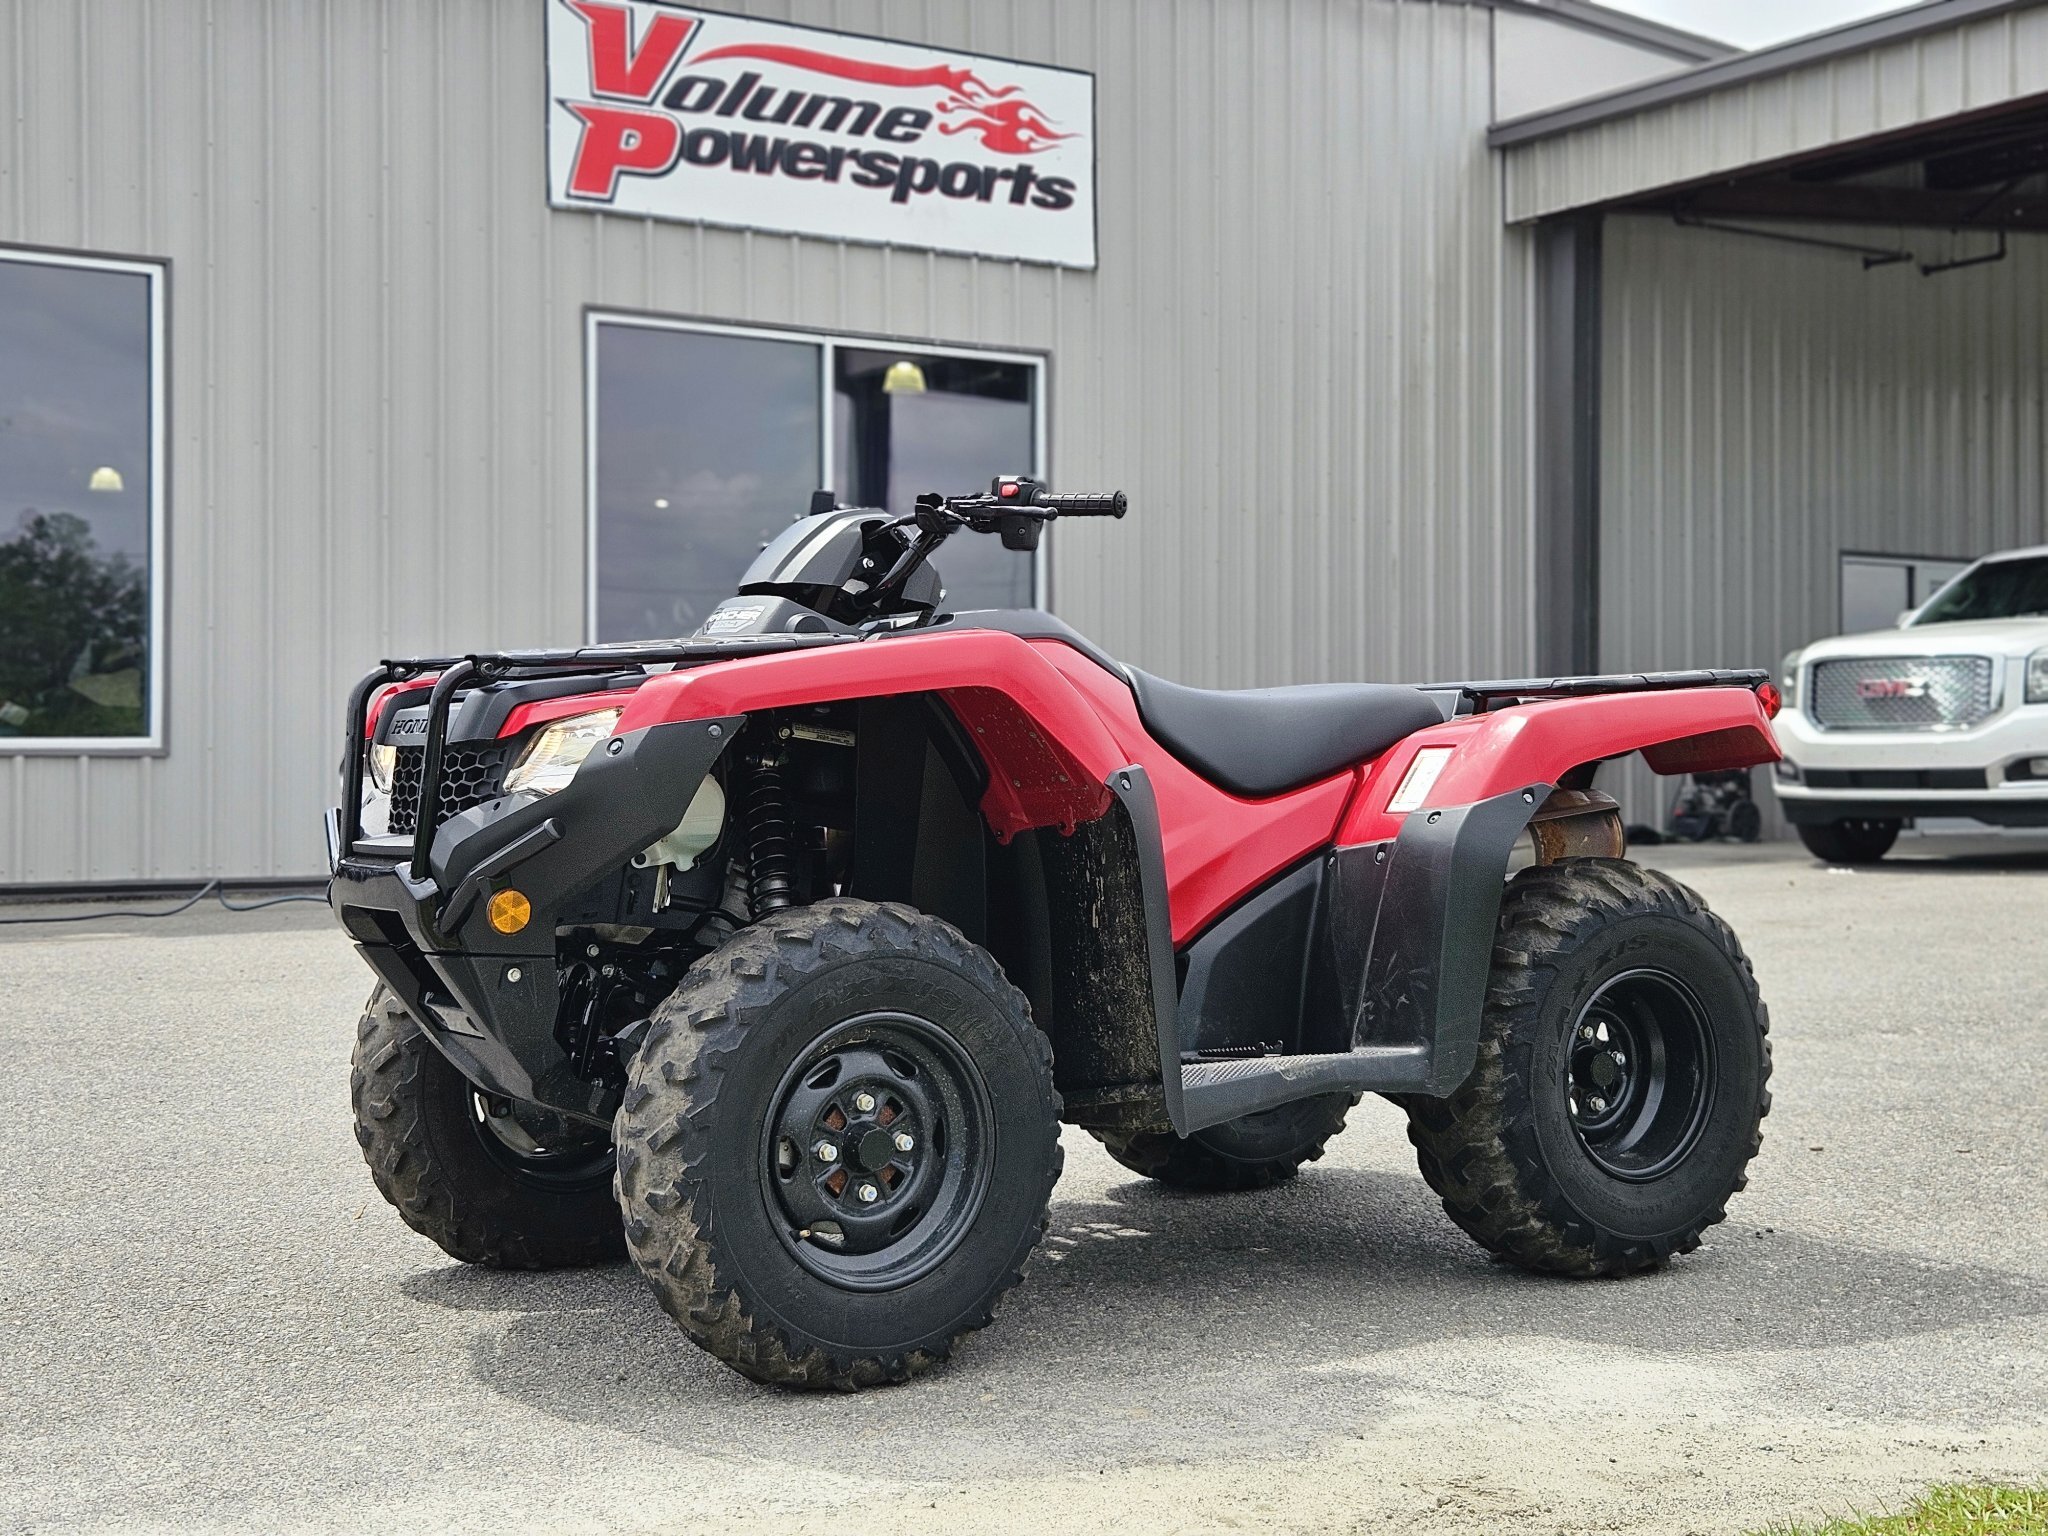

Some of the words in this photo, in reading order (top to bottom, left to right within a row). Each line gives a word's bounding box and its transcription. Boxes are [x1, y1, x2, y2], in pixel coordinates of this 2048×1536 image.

[560, 0, 933, 144] Volume
[556, 98, 1076, 210] Powersports
[391, 718, 428, 735] HON
